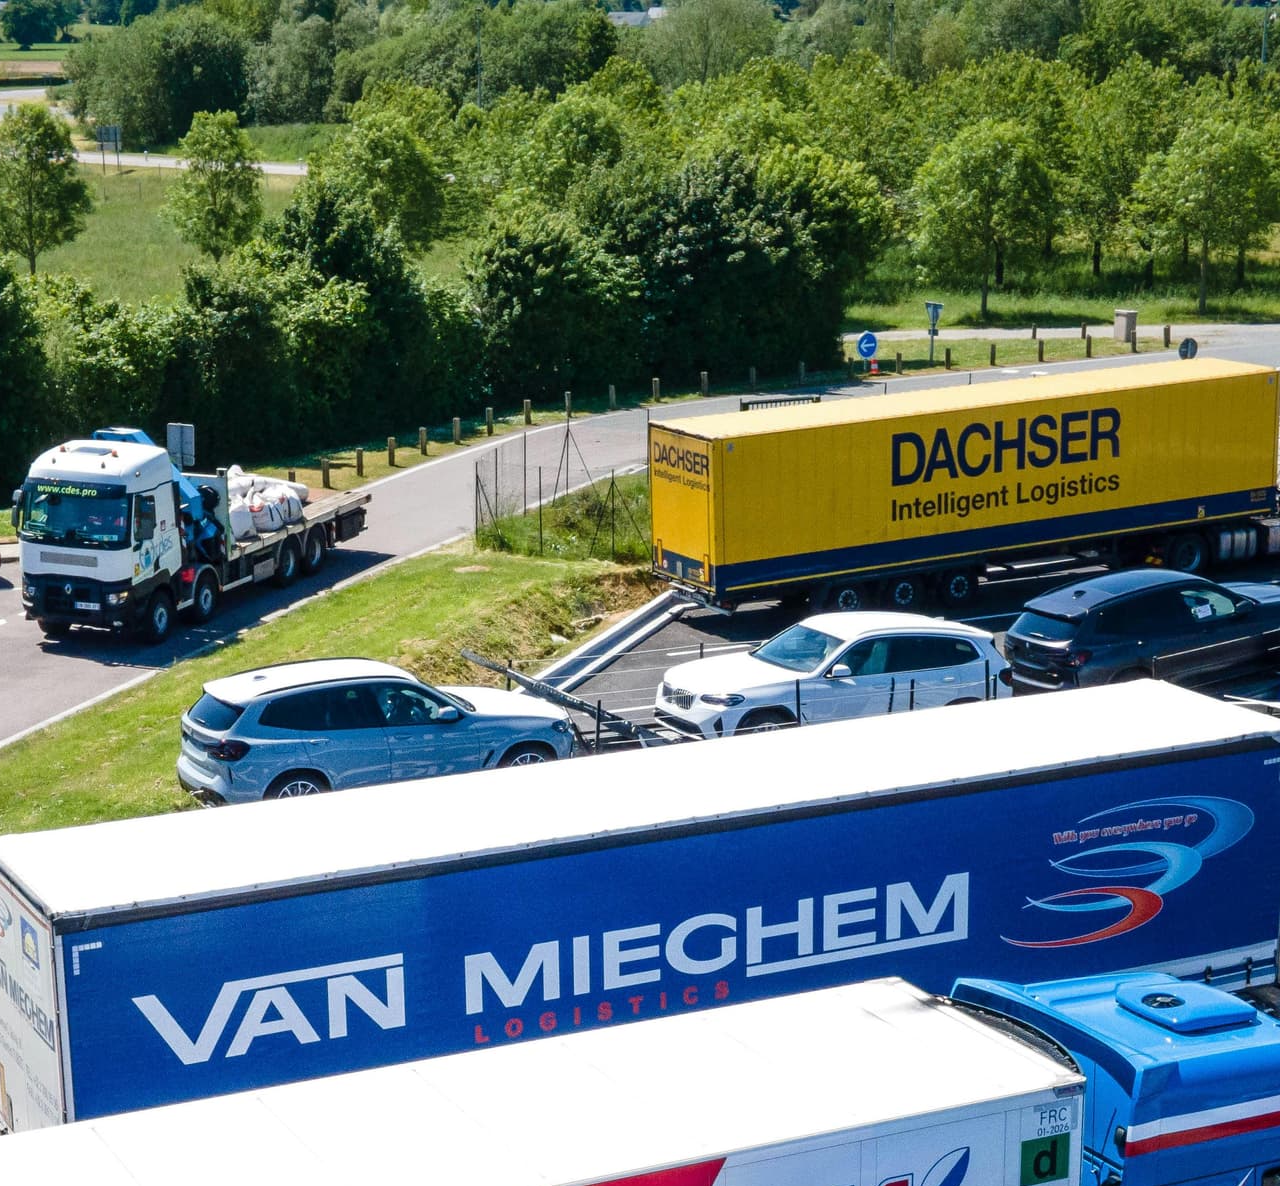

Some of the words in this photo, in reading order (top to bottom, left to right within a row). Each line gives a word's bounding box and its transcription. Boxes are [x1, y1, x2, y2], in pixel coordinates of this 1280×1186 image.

[653, 441, 710, 477] DACHSER
[892, 407, 1121, 487] DACHSER
[37, 484, 98, 497] www.cdes.pro
[892, 485, 1009, 522] Intelligent
[1016, 472, 1121, 506] Logistics
[1079, 828, 1100, 843] you
[1163, 815, 1184, 830] you
[1184, 813, 1198, 827] go
[131, 952, 406, 1065] VAN
[464, 871, 969, 1016] MIEGHEM
[474, 980, 730, 1044] LOGISTICS
[1037, 1122, 1070, 1137] 01-2026
[1039, 1107, 1068, 1126] FRC
[1033, 1138, 1057, 1179] d
